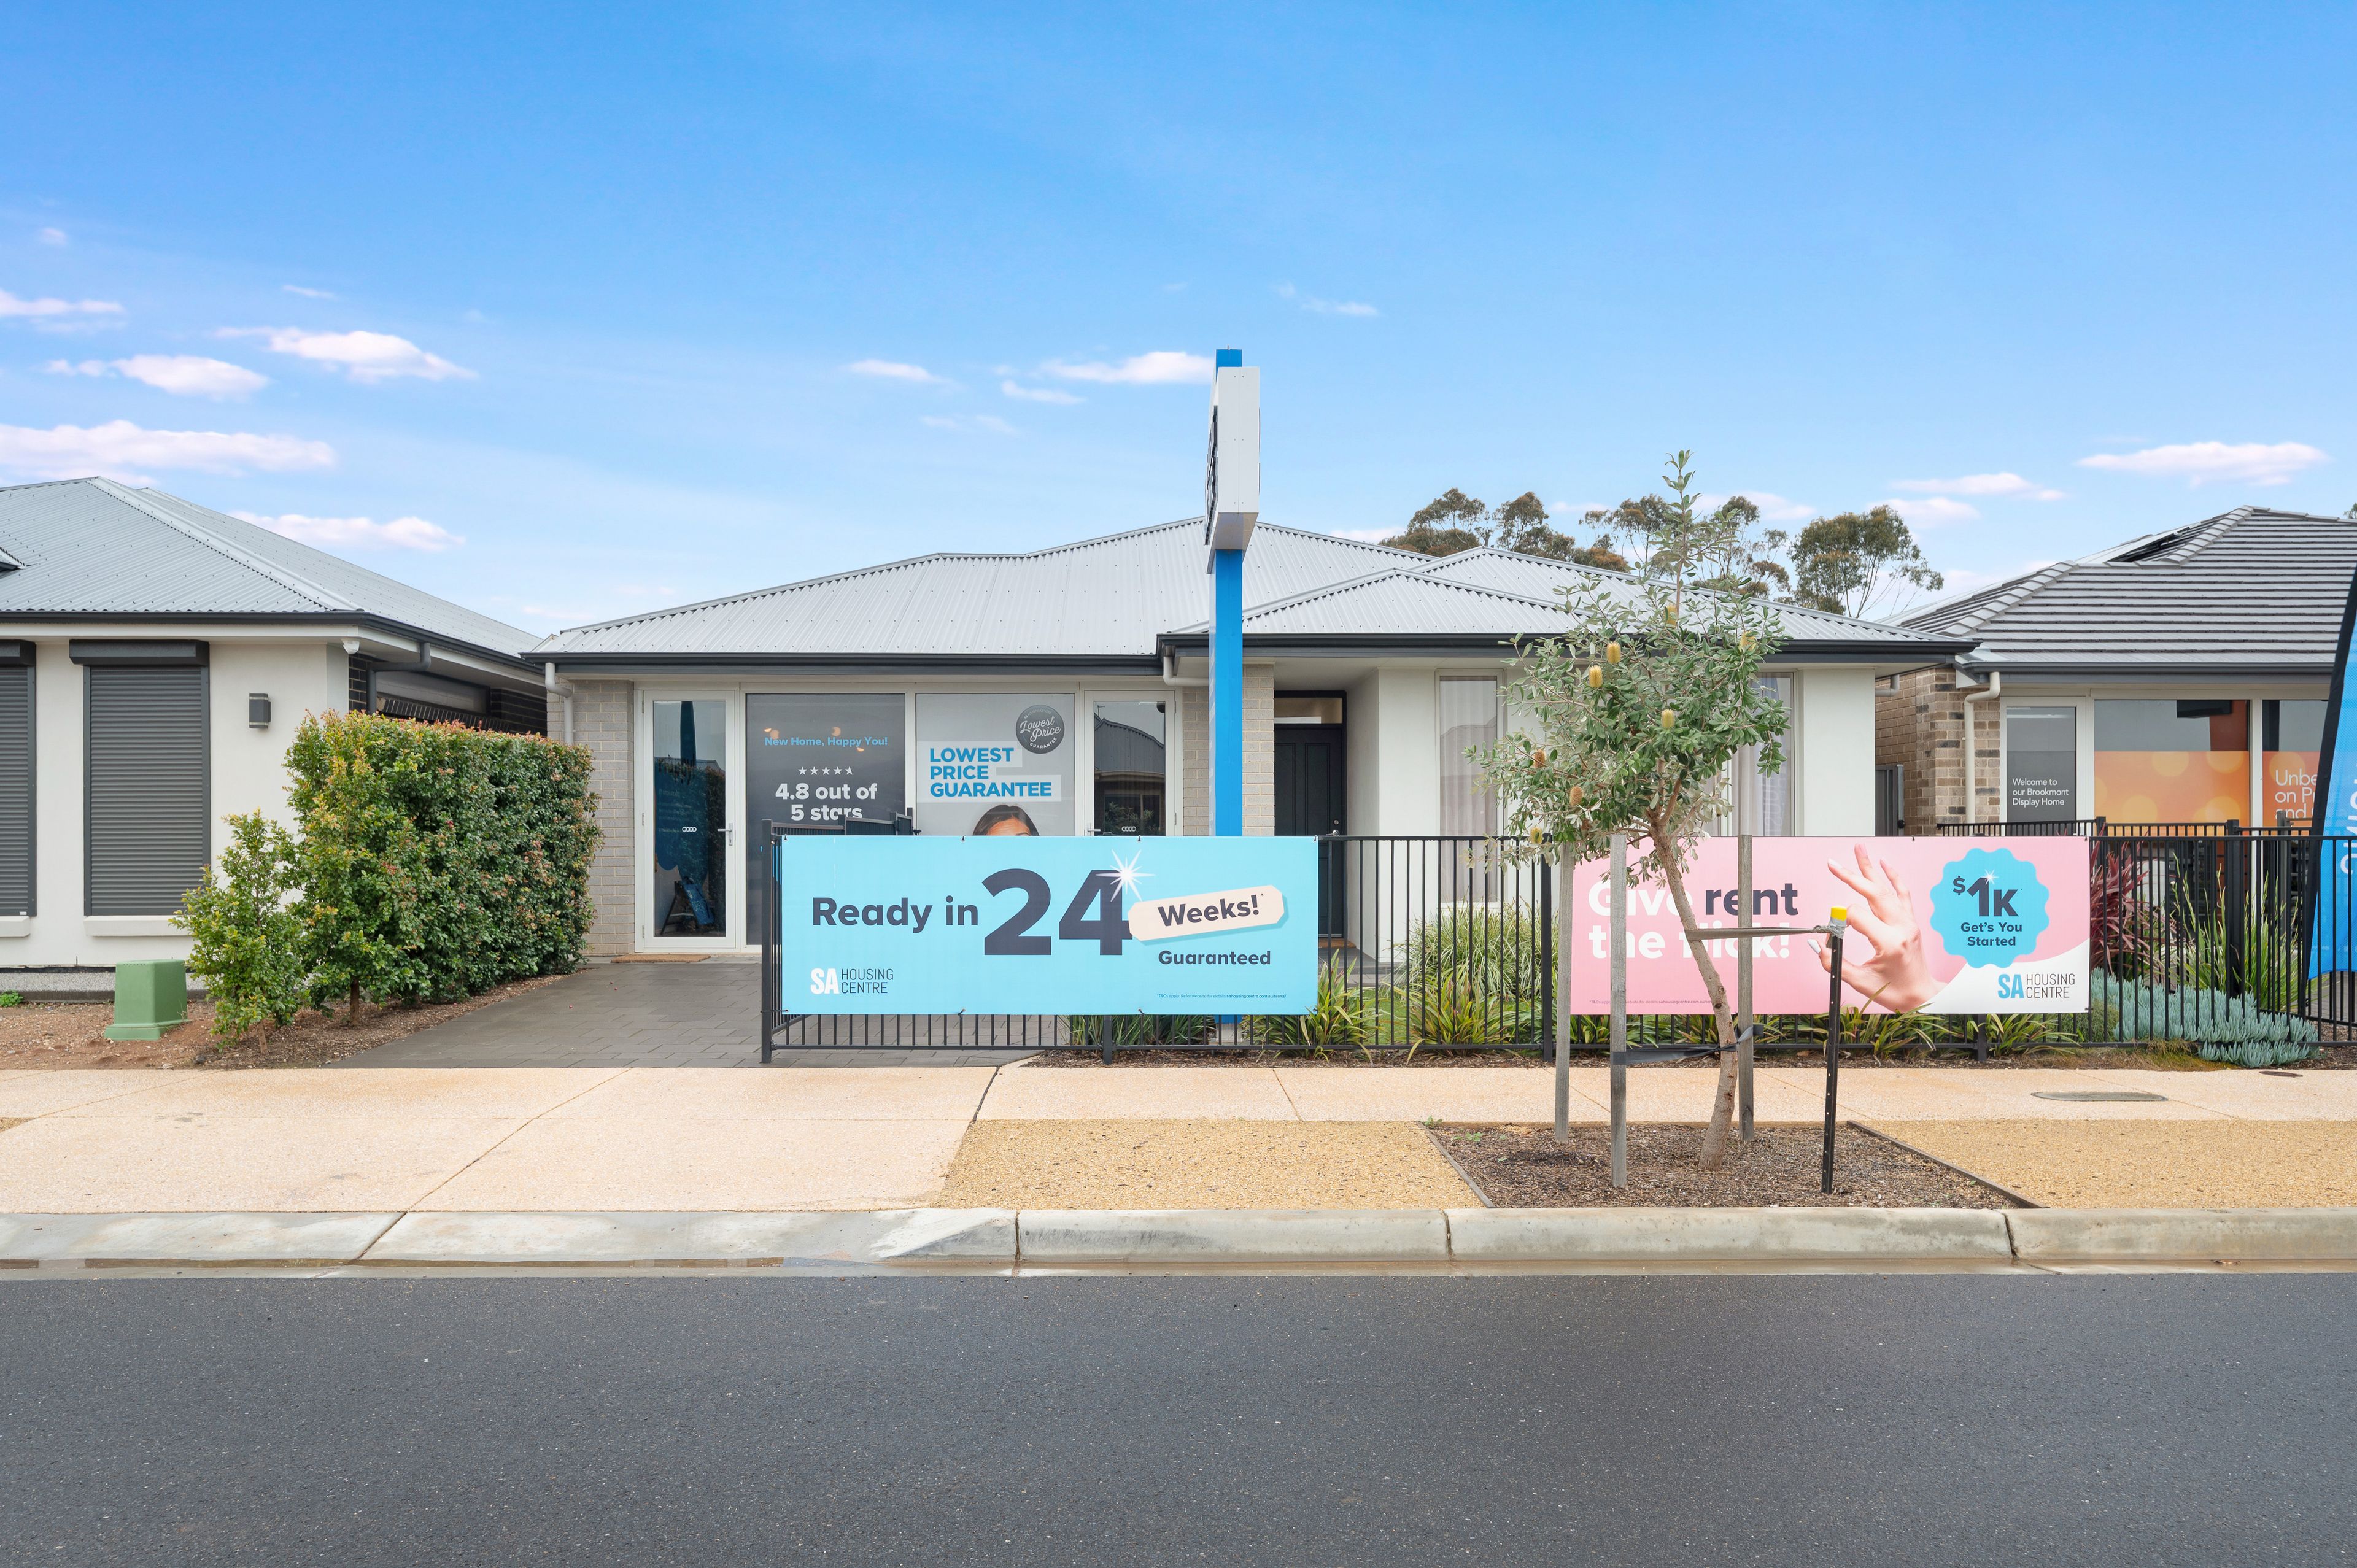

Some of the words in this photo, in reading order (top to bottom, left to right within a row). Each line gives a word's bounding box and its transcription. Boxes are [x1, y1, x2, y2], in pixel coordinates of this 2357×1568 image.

[1020, 715, 1055, 733] Lowest
[764, 737, 788, 746] New
[791, 737, 825, 747] Home,
[828, 737, 862, 747] Happy
[864, 737, 888, 746] You!
[1029, 727, 1061, 742] Price
[1029, 736, 1057, 749] GUARANTEE
[930, 747, 1015, 762] LOWEST
[930, 765, 989, 780] PRICE
[775, 783, 810, 800] 4.8
[815, 784, 851, 800] out
[856, 783, 878, 800] of
[930, 782, 1052, 797] GUARANTEE
[2027, 787, 2069, 796] Brookmont
[2275, 791, 2296, 803] on
[2012, 797, 2040, 808] Display
[2042, 797, 2065, 806] Home
[791, 804, 805, 821] 5
[813, 897, 932, 933] Ready
[945, 895, 978, 925] in
[982, 868, 1133, 956] 24
[1960, 922, 1994, 932] Get's
[1999, 922, 2022, 932] You
[1967, 936, 2016, 946] Started
[1158, 950, 1271, 965] Guaranteed
[810, 968, 840, 994] SA
[841, 968, 894, 980] HOUSING
[841, 982, 888, 994] CENTRE
[1997, 973, 2025, 999] SA
[2026, 973, 2075, 986] HOUSING
[2026, 986, 2070, 998] CENTRE
